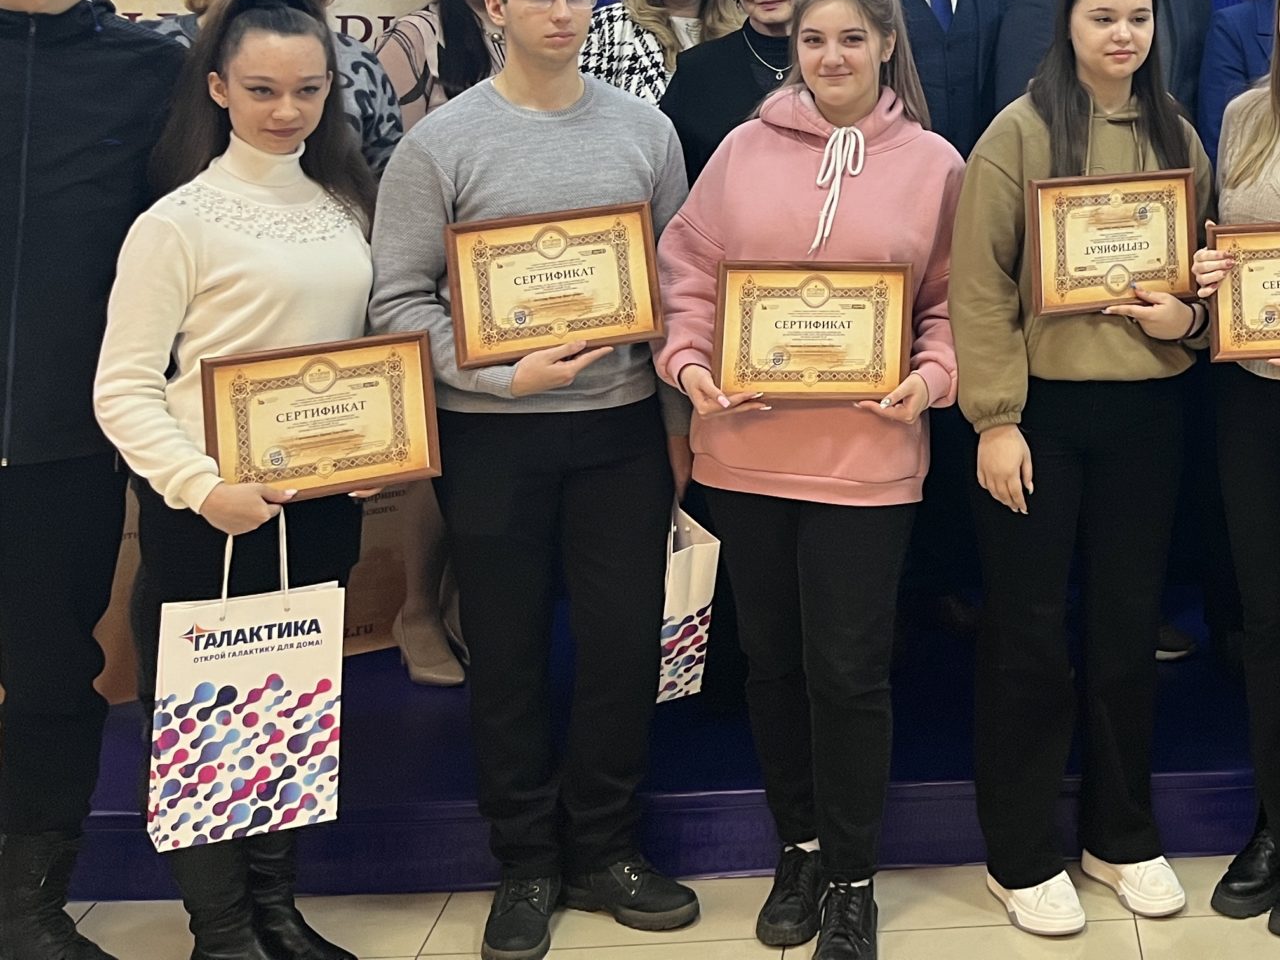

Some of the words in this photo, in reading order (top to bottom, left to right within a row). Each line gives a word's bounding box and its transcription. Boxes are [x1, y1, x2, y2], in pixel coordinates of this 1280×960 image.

[1084, 241, 1150, 255] СЕРТИФИКАТ
[513, 266, 596, 287] СЕРТИФИКАТ
[774, 320, 853, 330] СЕРТИФИКАТ
[276, 400, 367, 424] СЕРТИФИКАТ
[193, 618, 322, 652] ГАЛАКТИКА
[193, 652, 227, 664] ОТКРОЙ
[227, 645, 276, 659] ГАЛАКТИКУ
[276, 642, 295, 652] ДЛЯ
[296, 639, 324, 649] ДОМА!
